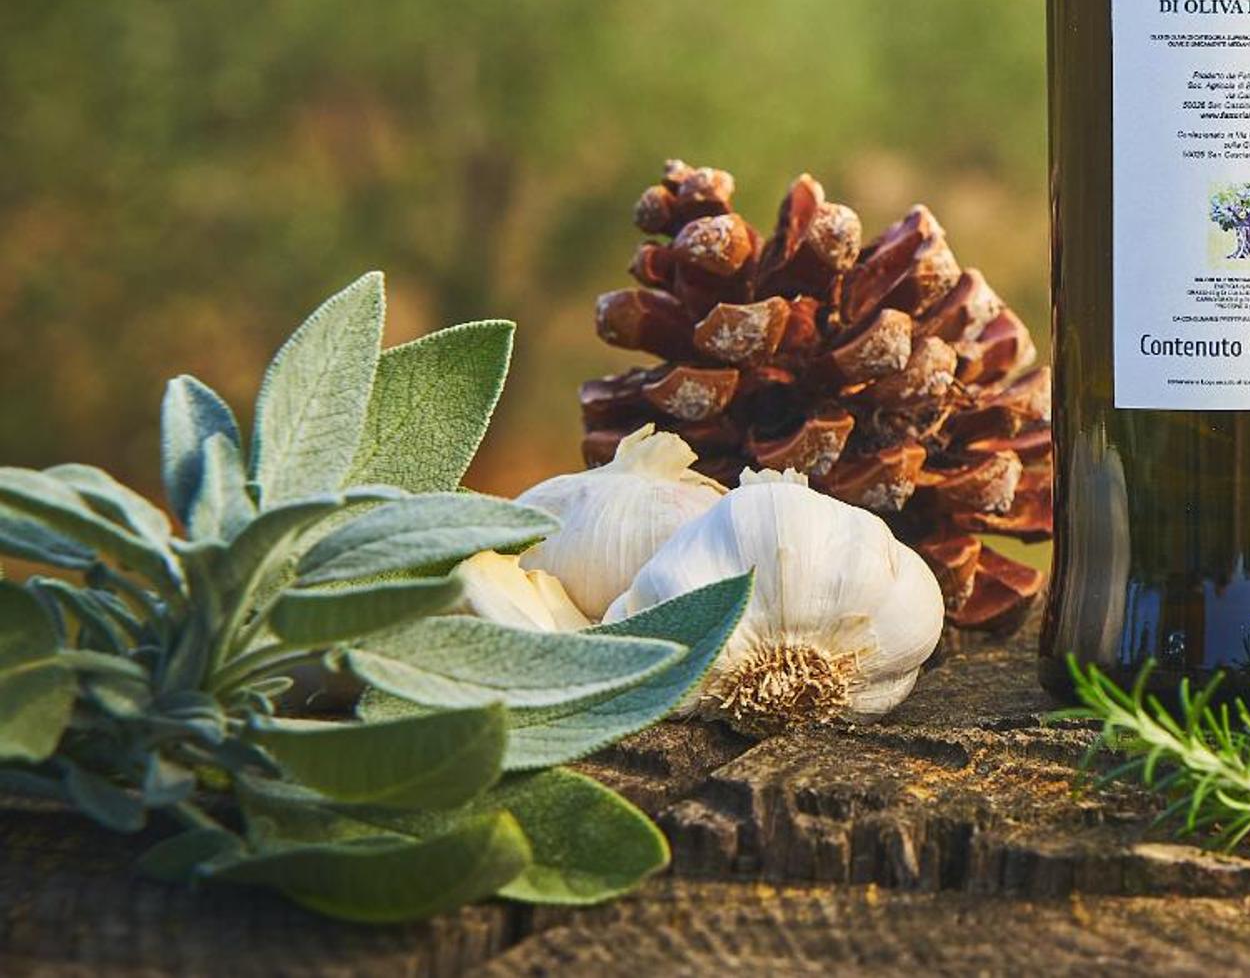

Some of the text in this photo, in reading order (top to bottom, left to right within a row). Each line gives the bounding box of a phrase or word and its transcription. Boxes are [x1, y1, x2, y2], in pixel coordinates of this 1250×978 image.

[1159, 0, 1179, 13] DI
[1184, 0, 1244, 14] OLIVA
[1140, 334, 1242, 357] Contenuto
